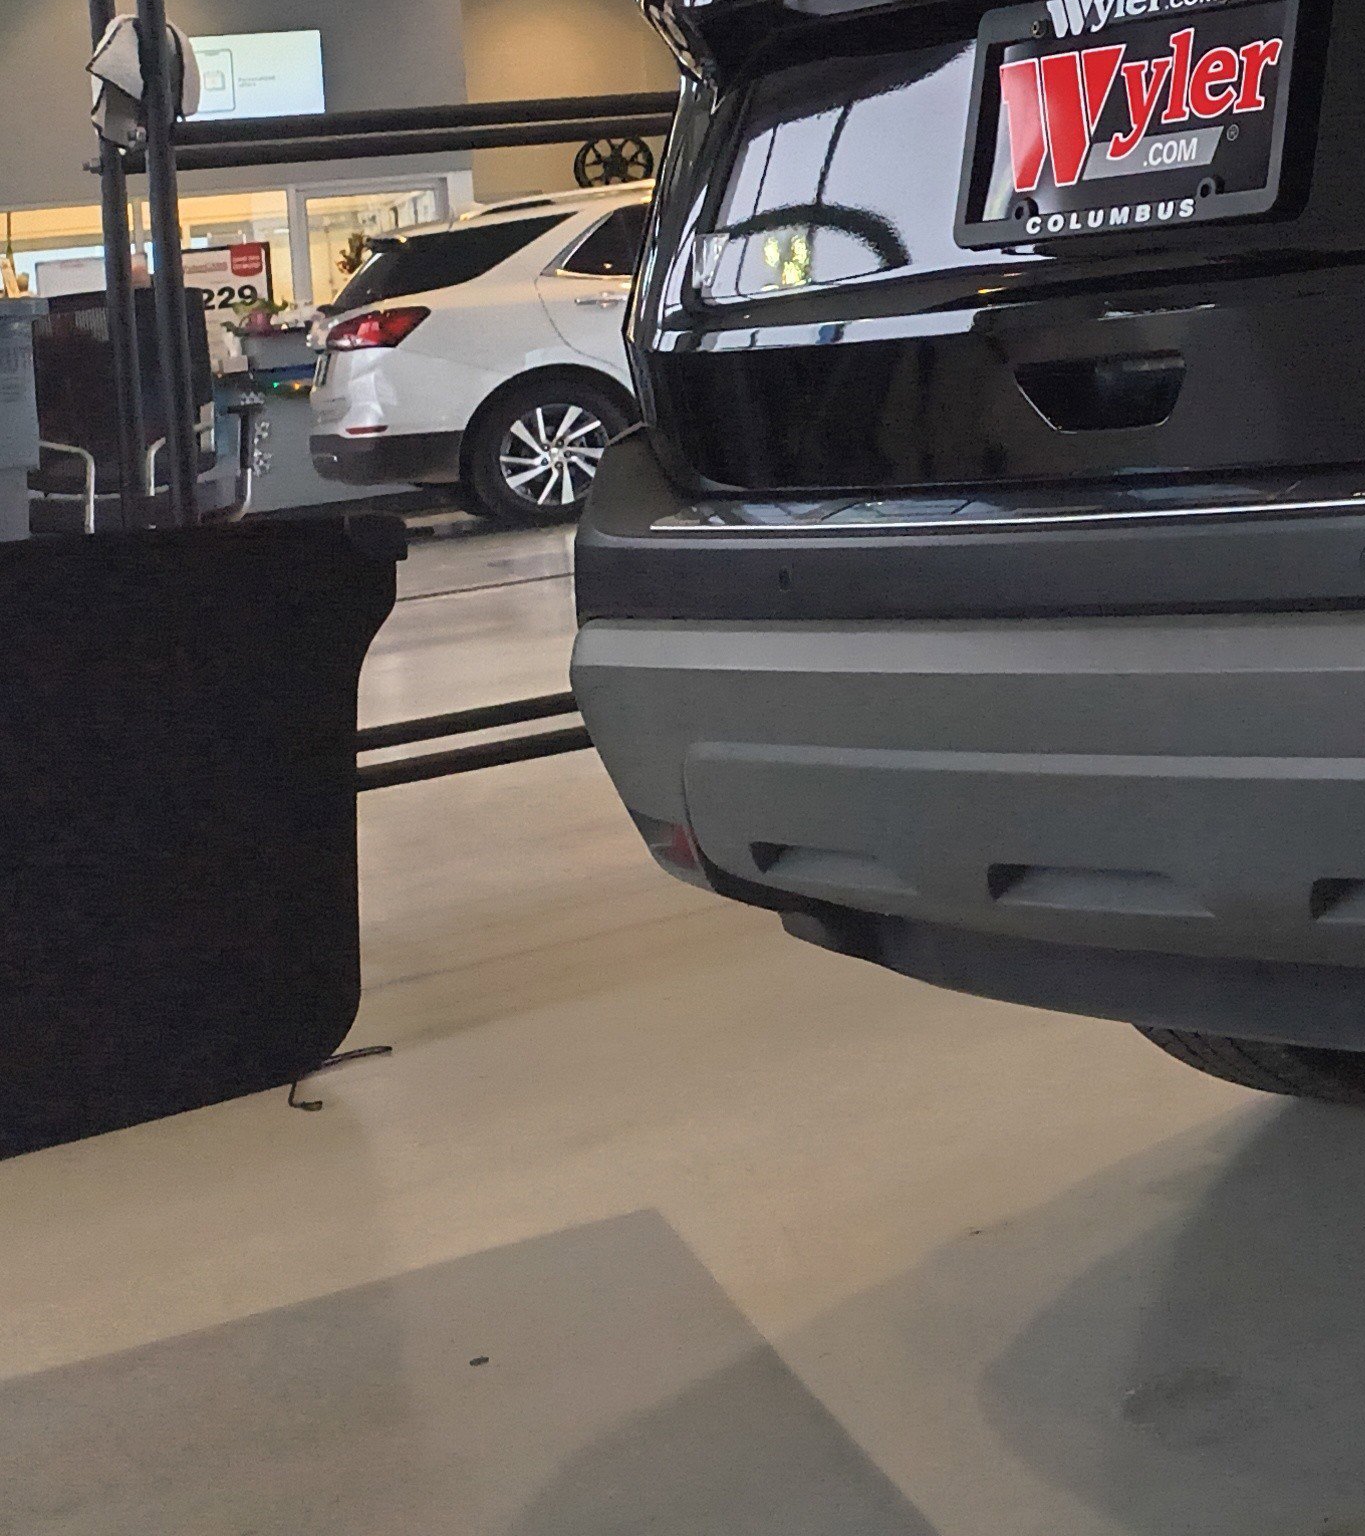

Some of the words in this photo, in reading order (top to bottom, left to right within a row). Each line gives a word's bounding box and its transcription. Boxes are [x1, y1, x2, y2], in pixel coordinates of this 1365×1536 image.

[1000, 27, 1283, 193] Wyler
[1143, 137, 1198, 166] .COM
[1025, 198, 1197, 235] COLUMBUS
